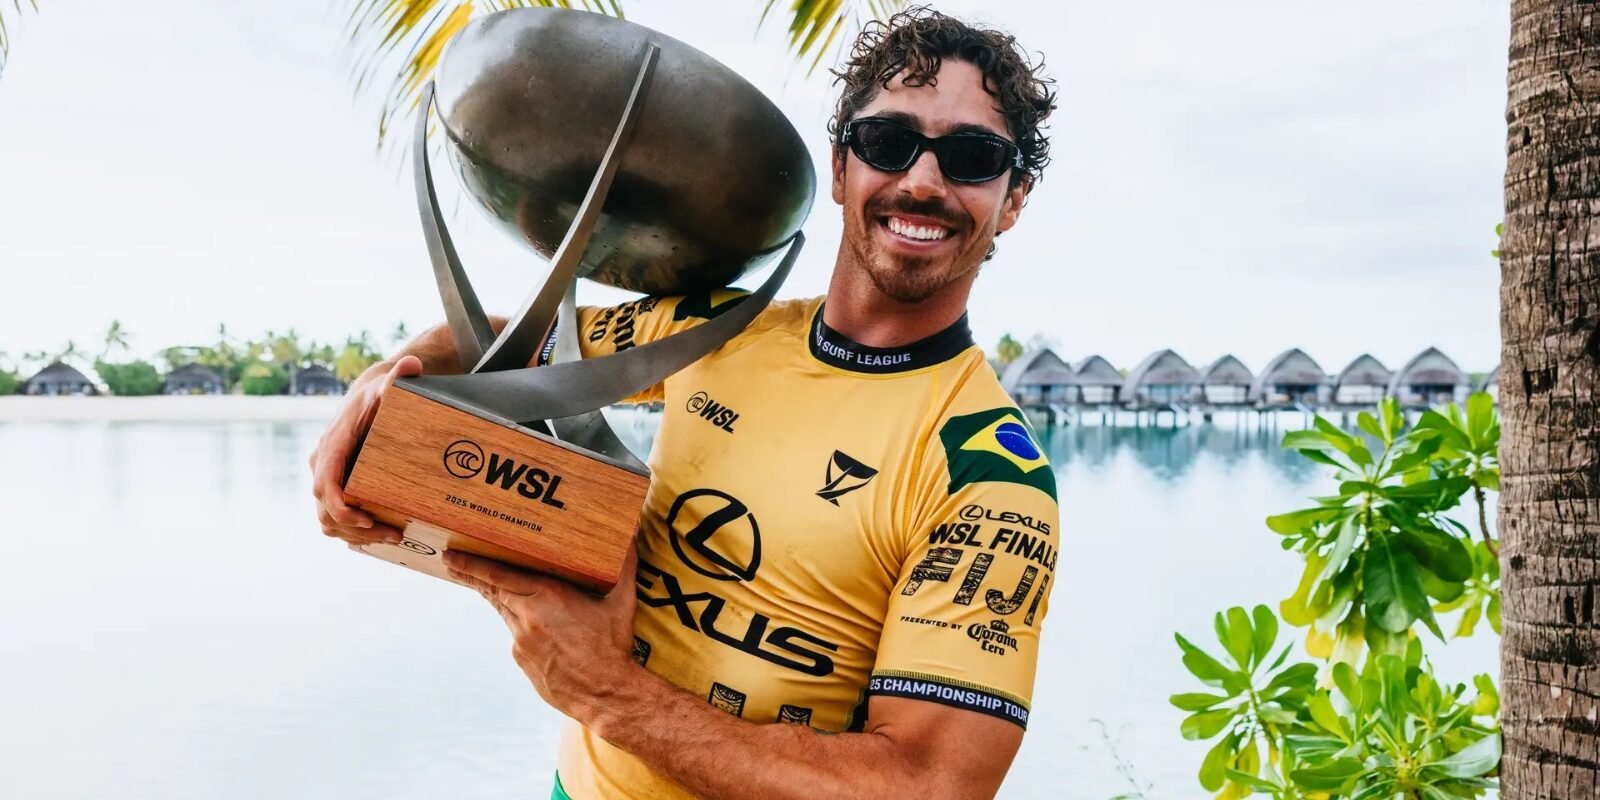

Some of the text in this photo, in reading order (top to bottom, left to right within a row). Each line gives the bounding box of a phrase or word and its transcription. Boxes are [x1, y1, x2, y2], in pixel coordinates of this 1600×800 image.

[821, 341, 911, 366] SURF LEAGUE
[700, 399, 740, 434] WSL
[485, 452, 565, 509] WSL
[445, 494, 543, 533] 2025 WORLD CHAMPION
[985, 509, 1051, 536] LEXUS
[928, 522, 1058, 573] WSL FINALS
[901, 546, 1051, 627] FIJI
[636, 558, 840, 677] EXUS
[900, 615, 963, 631] PRESENTED BY
[966, 622, 1019, 652] Corona
[980, 640, 1005, 656] Cero
[869, 678, 1028, 723] 25 CHAMPIONSHIP TOUR
